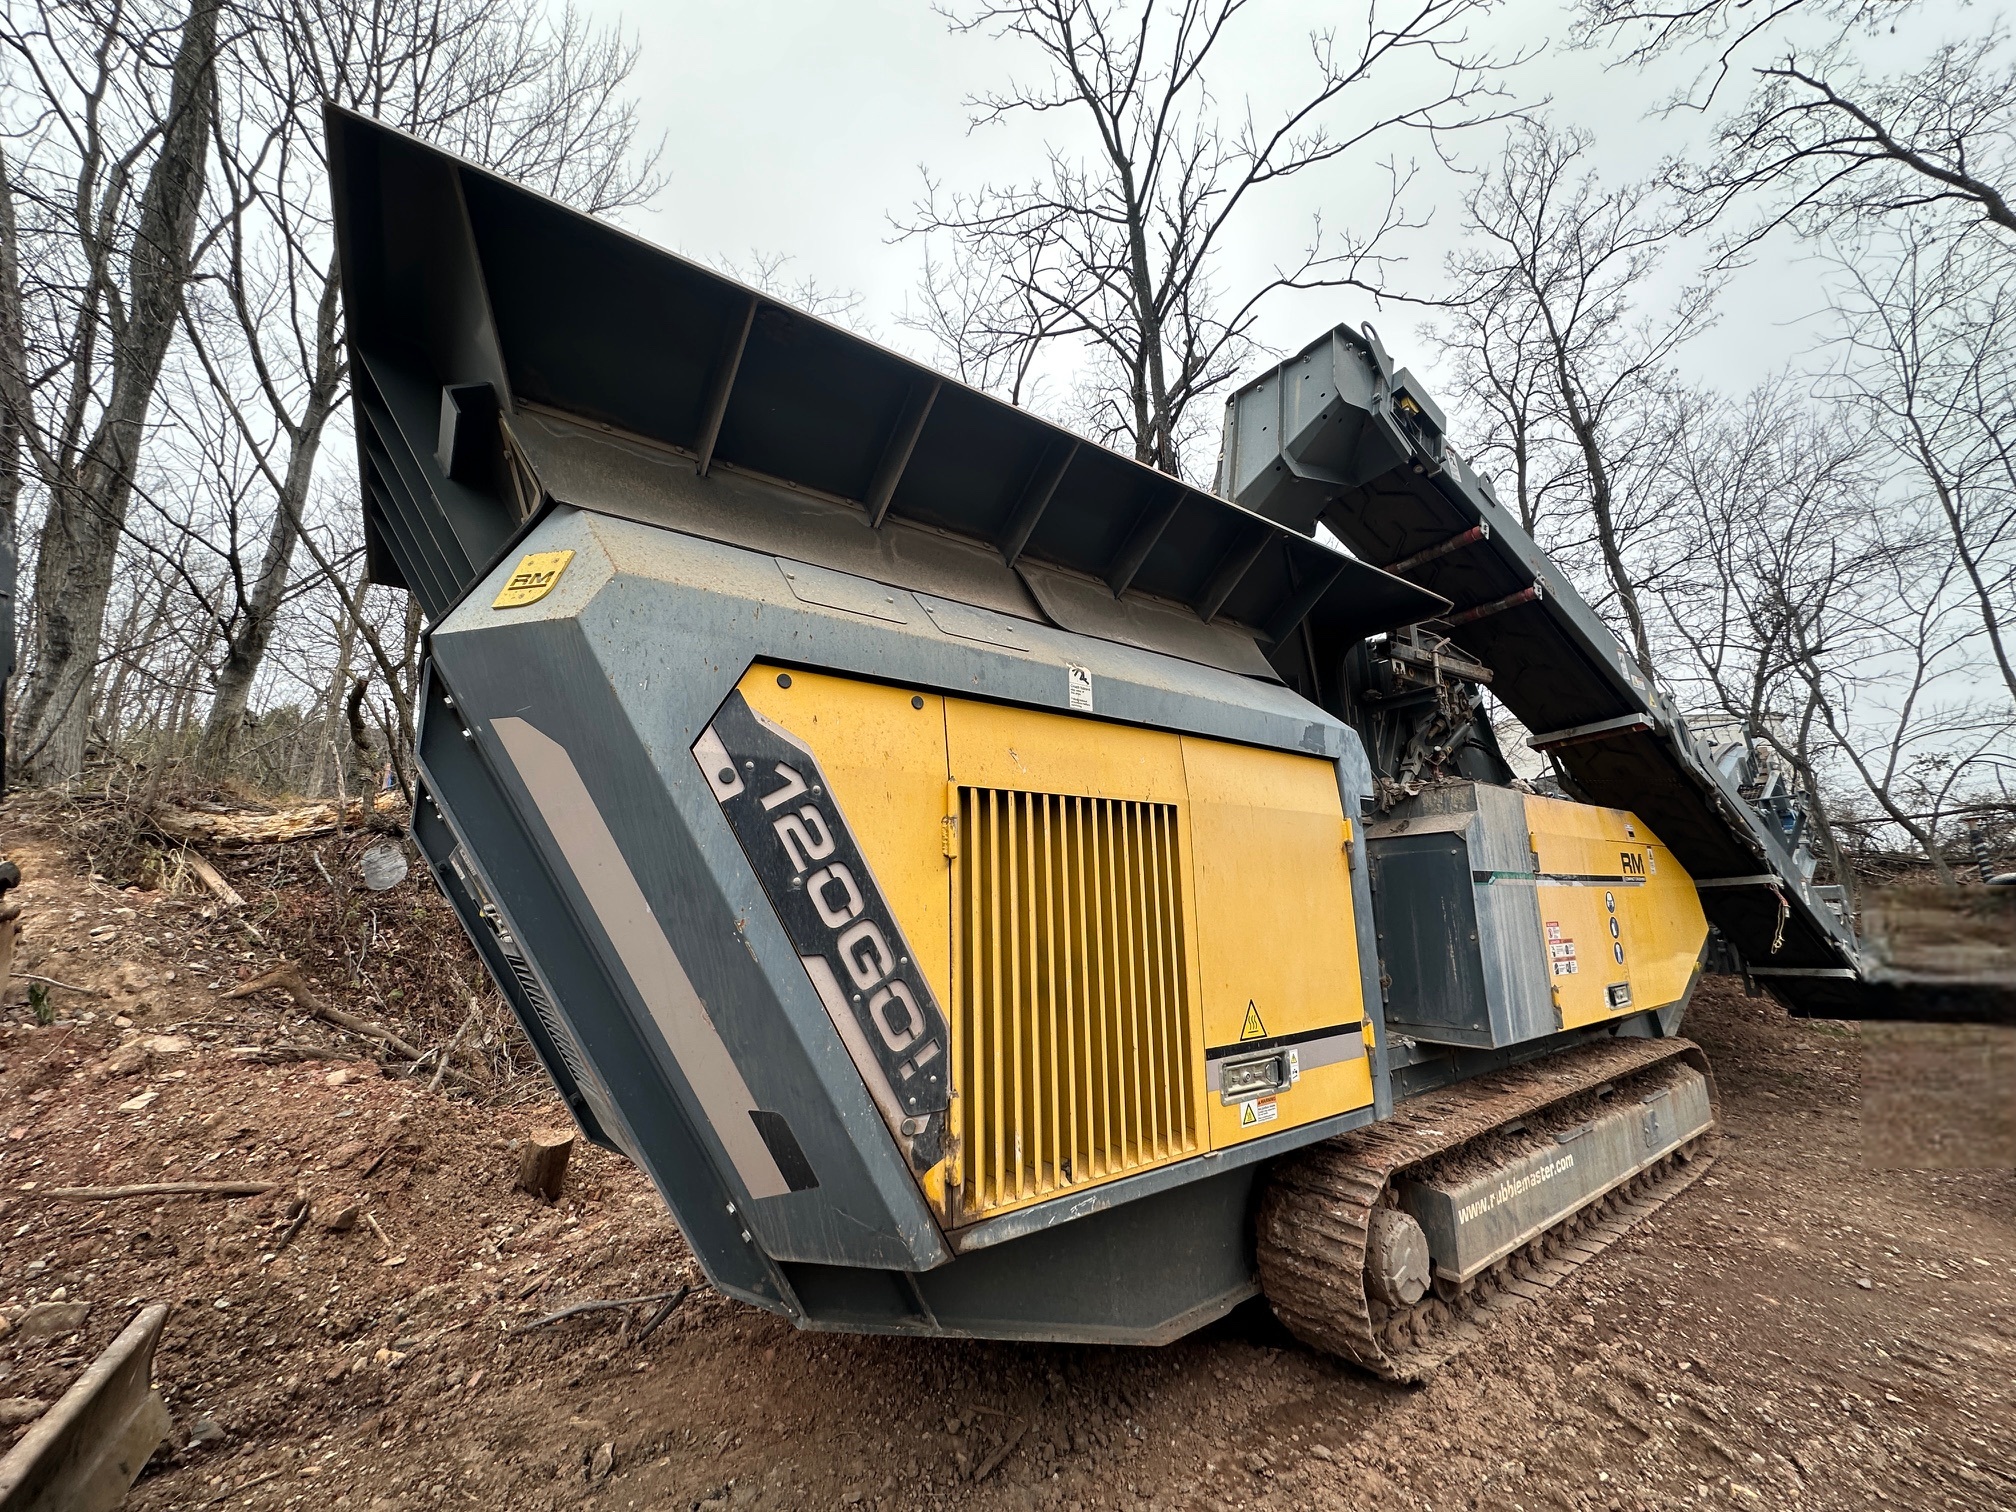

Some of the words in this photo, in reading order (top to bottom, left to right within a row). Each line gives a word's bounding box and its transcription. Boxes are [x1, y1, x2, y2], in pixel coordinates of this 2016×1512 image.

[509, 570, 556, 587] RM
[1620, 852, 1645, 874] RM
[760, 760, 941, 1081] 120GO!
